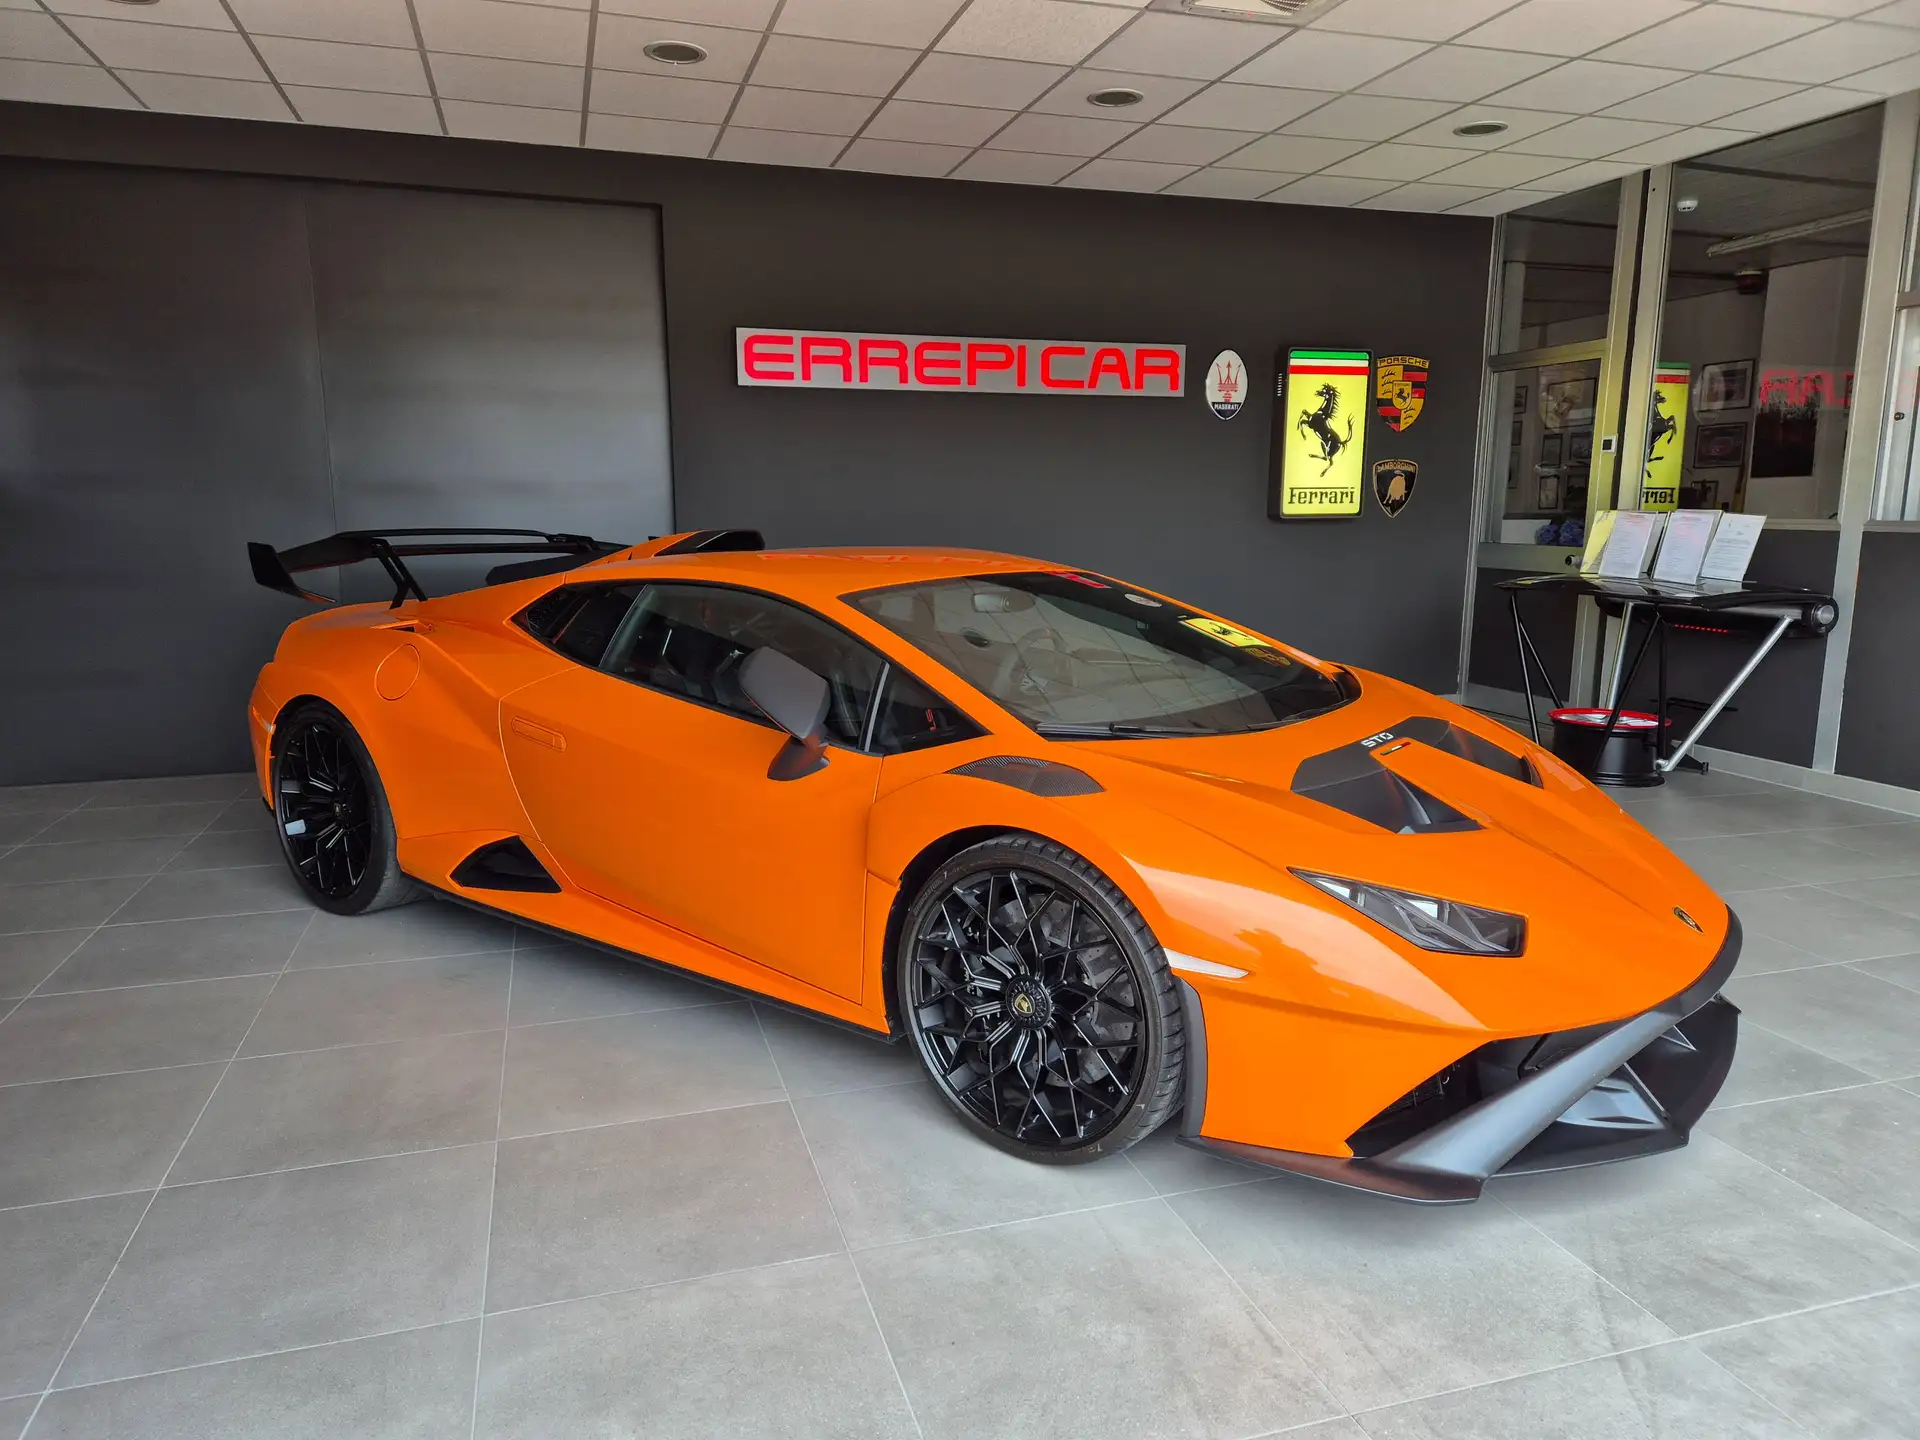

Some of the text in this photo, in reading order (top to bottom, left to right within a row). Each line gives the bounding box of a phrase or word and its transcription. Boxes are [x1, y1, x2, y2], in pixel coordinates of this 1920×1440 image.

[743, 334, 1180, 391] ERREPI CAR
[1379, 356, 1427, 368] PORSCHE
[1376, 461, 1416, 474] LAMBORGHINI
[1287, 486, 1356, 505] Ferrari
[1360, 731, 1394, 748] STO
